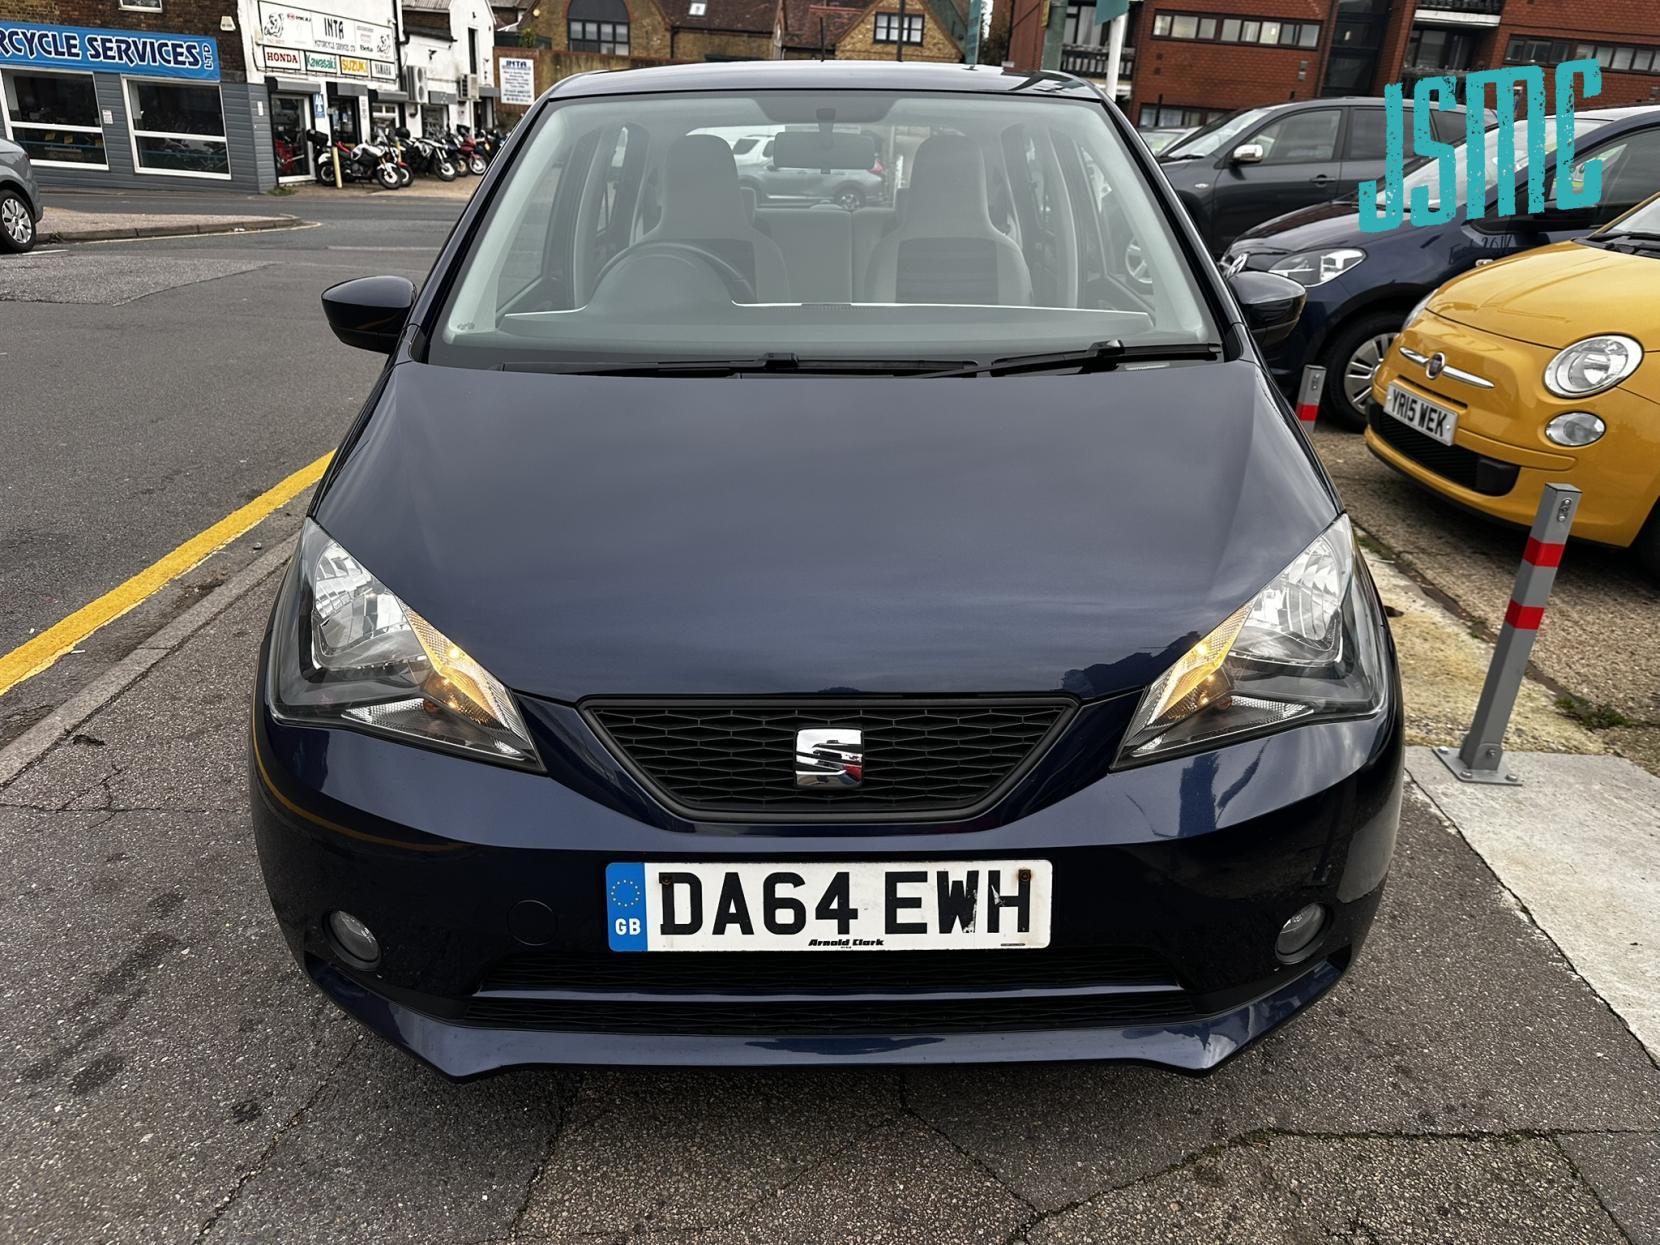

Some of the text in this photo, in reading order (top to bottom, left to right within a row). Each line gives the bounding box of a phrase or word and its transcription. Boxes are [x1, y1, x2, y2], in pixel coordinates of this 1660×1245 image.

[323, 17, 344, 40] INTA
[86, 35, 201, 69] SERVICES
[203, 43, 213, 69] LTD
[266, 52, 298, 63] HONDA
[306, 54, 336, 70] Kawasaki
[342, 58, 368, 73] SUZUKI
[375, 63, 392, 76] YAMAHA
[1392, 389, 1447, 437] YR15 WEK
[658, 869, 1031, 936] DA64 EWH
[615, 918, 641, 935] GB
[808, 938, 850, 947] Arnold
